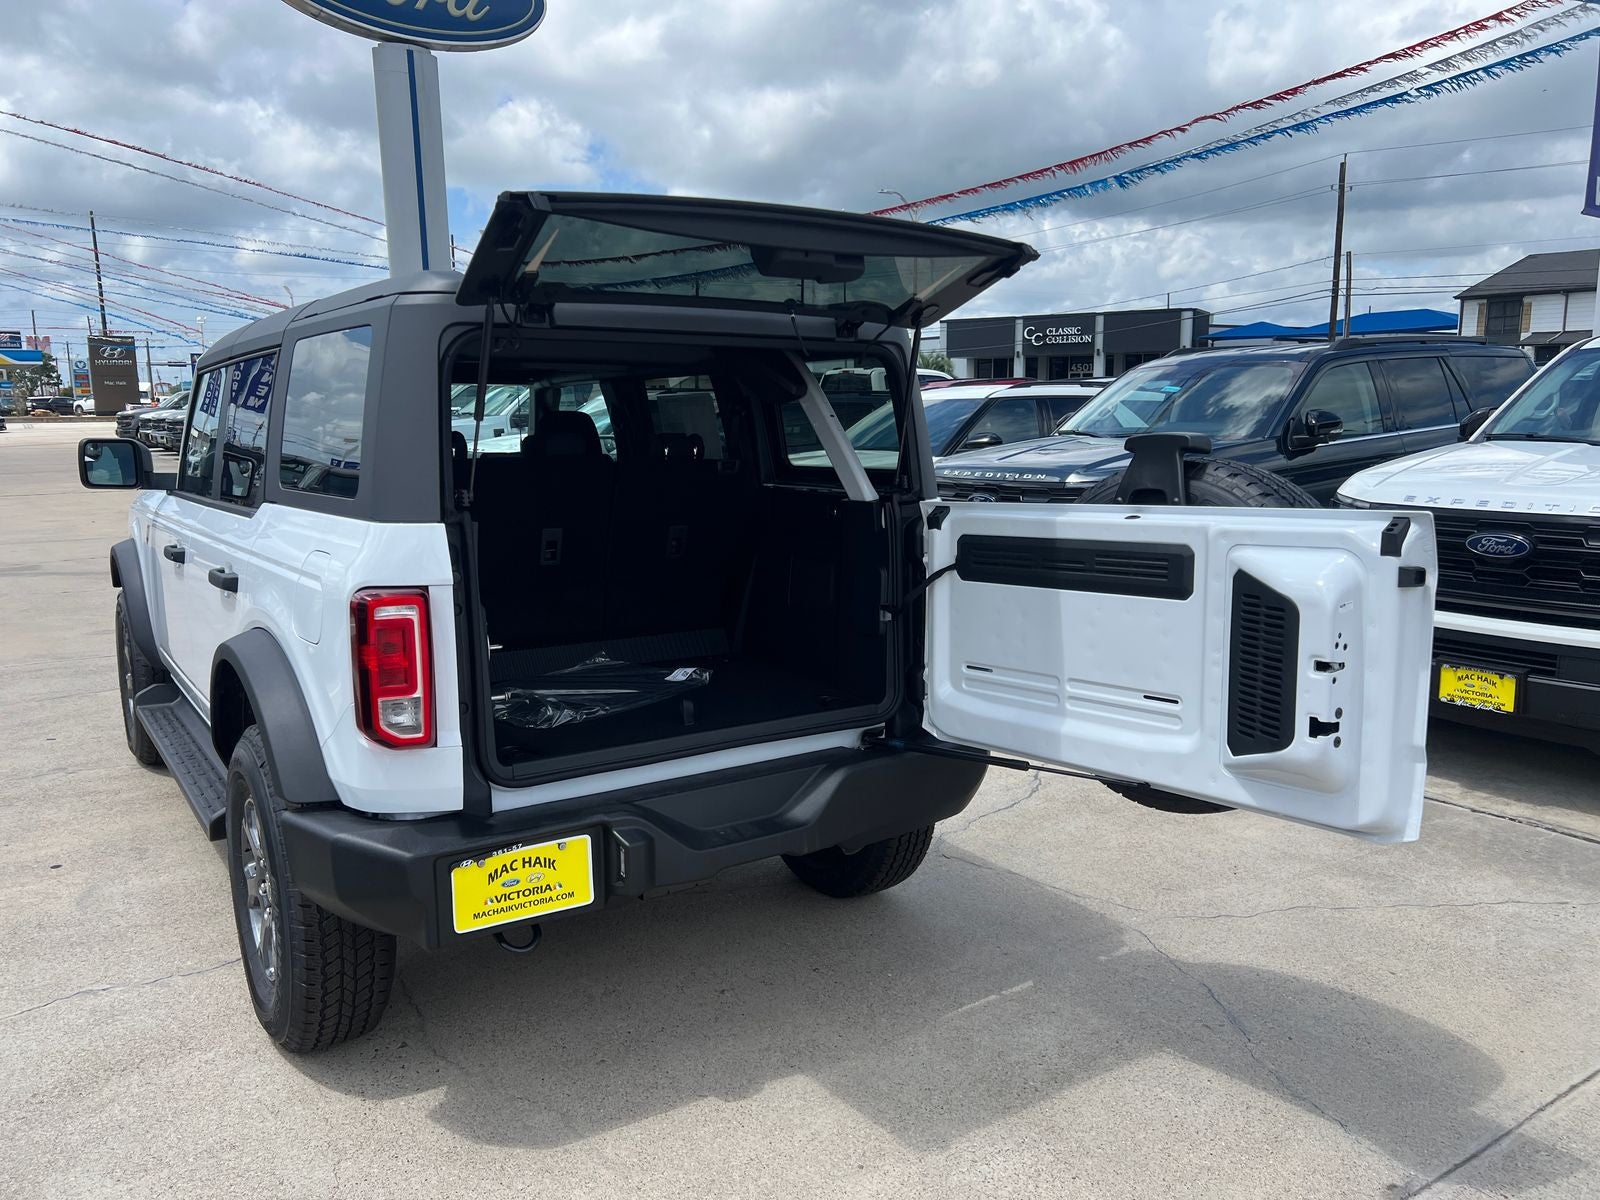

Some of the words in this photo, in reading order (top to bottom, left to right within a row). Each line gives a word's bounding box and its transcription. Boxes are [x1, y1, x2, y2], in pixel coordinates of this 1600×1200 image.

[1046, 326, 1081, 336] CLASSIC
[1046, 335, 1092, 344] COLLISION
[1071, 363, 1093, 372] 4501
[943, 470, 1047, 480] EXPEDITION
[1477, 536, 1518, 555] Ford
[1457, 673, 1475, 682] MAC
[1477, 675, 1498, 688] HAIK
[1459, 689, 1493, 700] VICTORIA
[487, 859, 518, 886] MAC
[521, 856, 557, 871] HAIK
[494, 884, 553, 904] VICTORIA
[472, 891, 575, 920] MACHAIKVICTORIA.COM
